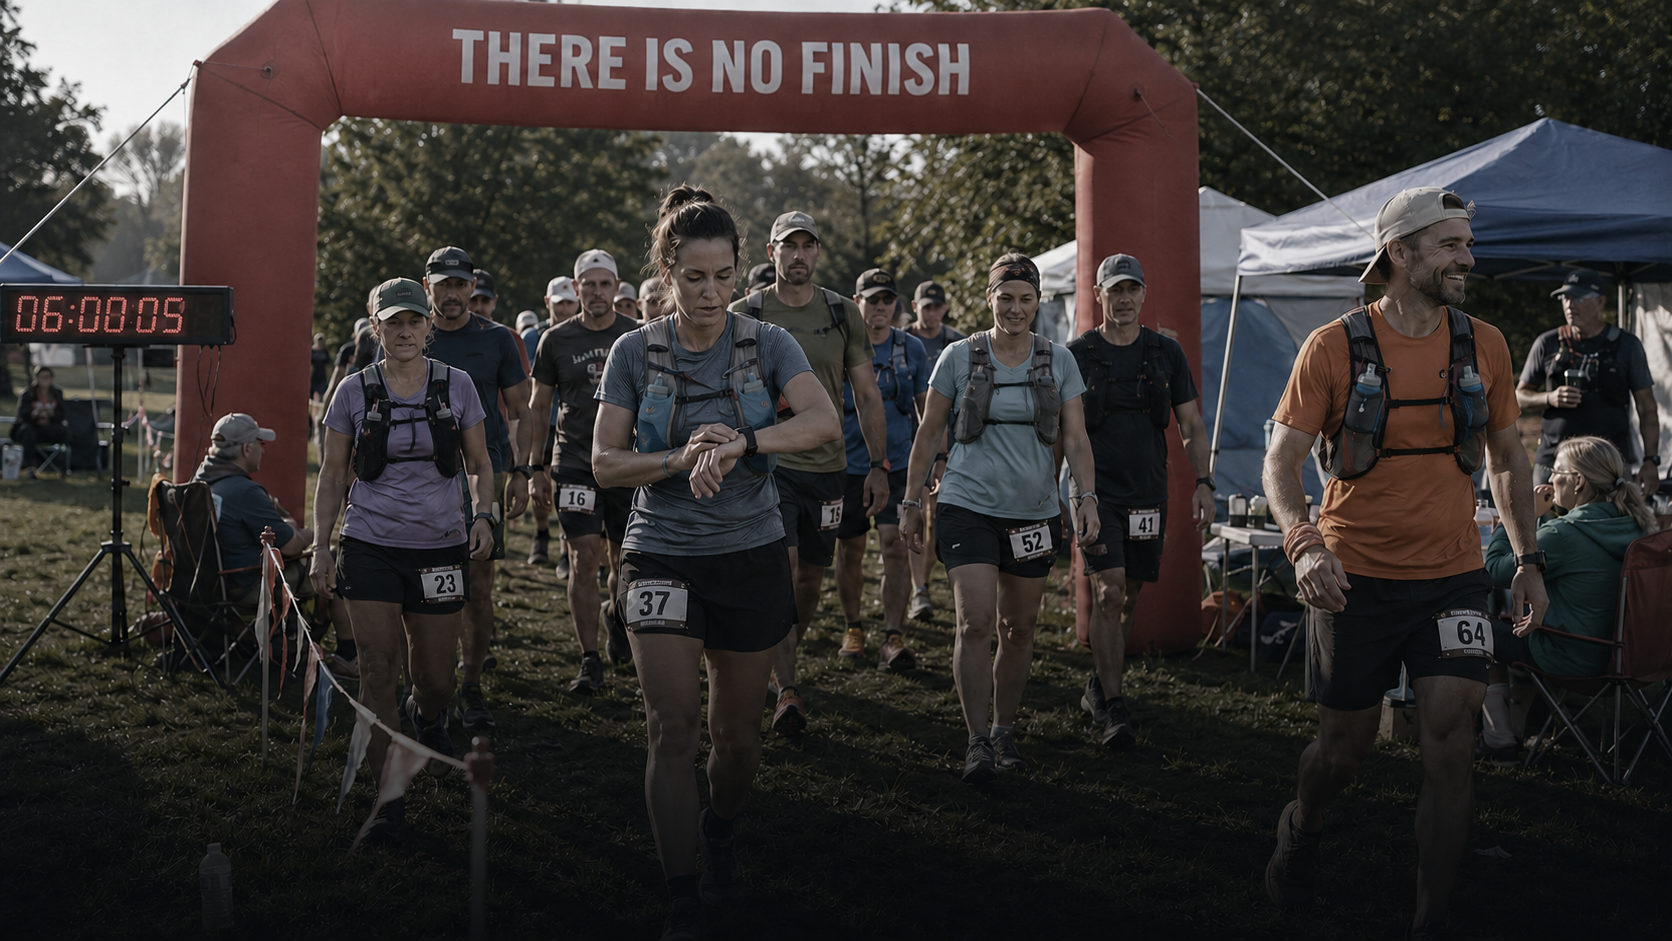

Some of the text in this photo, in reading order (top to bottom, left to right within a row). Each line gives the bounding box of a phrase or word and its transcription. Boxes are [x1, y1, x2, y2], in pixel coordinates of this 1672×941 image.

[452, 28, 970, 97] THERE IS NO FINISH
[568, 490, 586, 506] 16
[1138, 516, 1153, 533] 41
[1021, 531, 1044, 553] 52
[434, 573, 456, 595] 23
[638, 590, 671, 617] 37
[1457, 620, 1486, 647] 64
